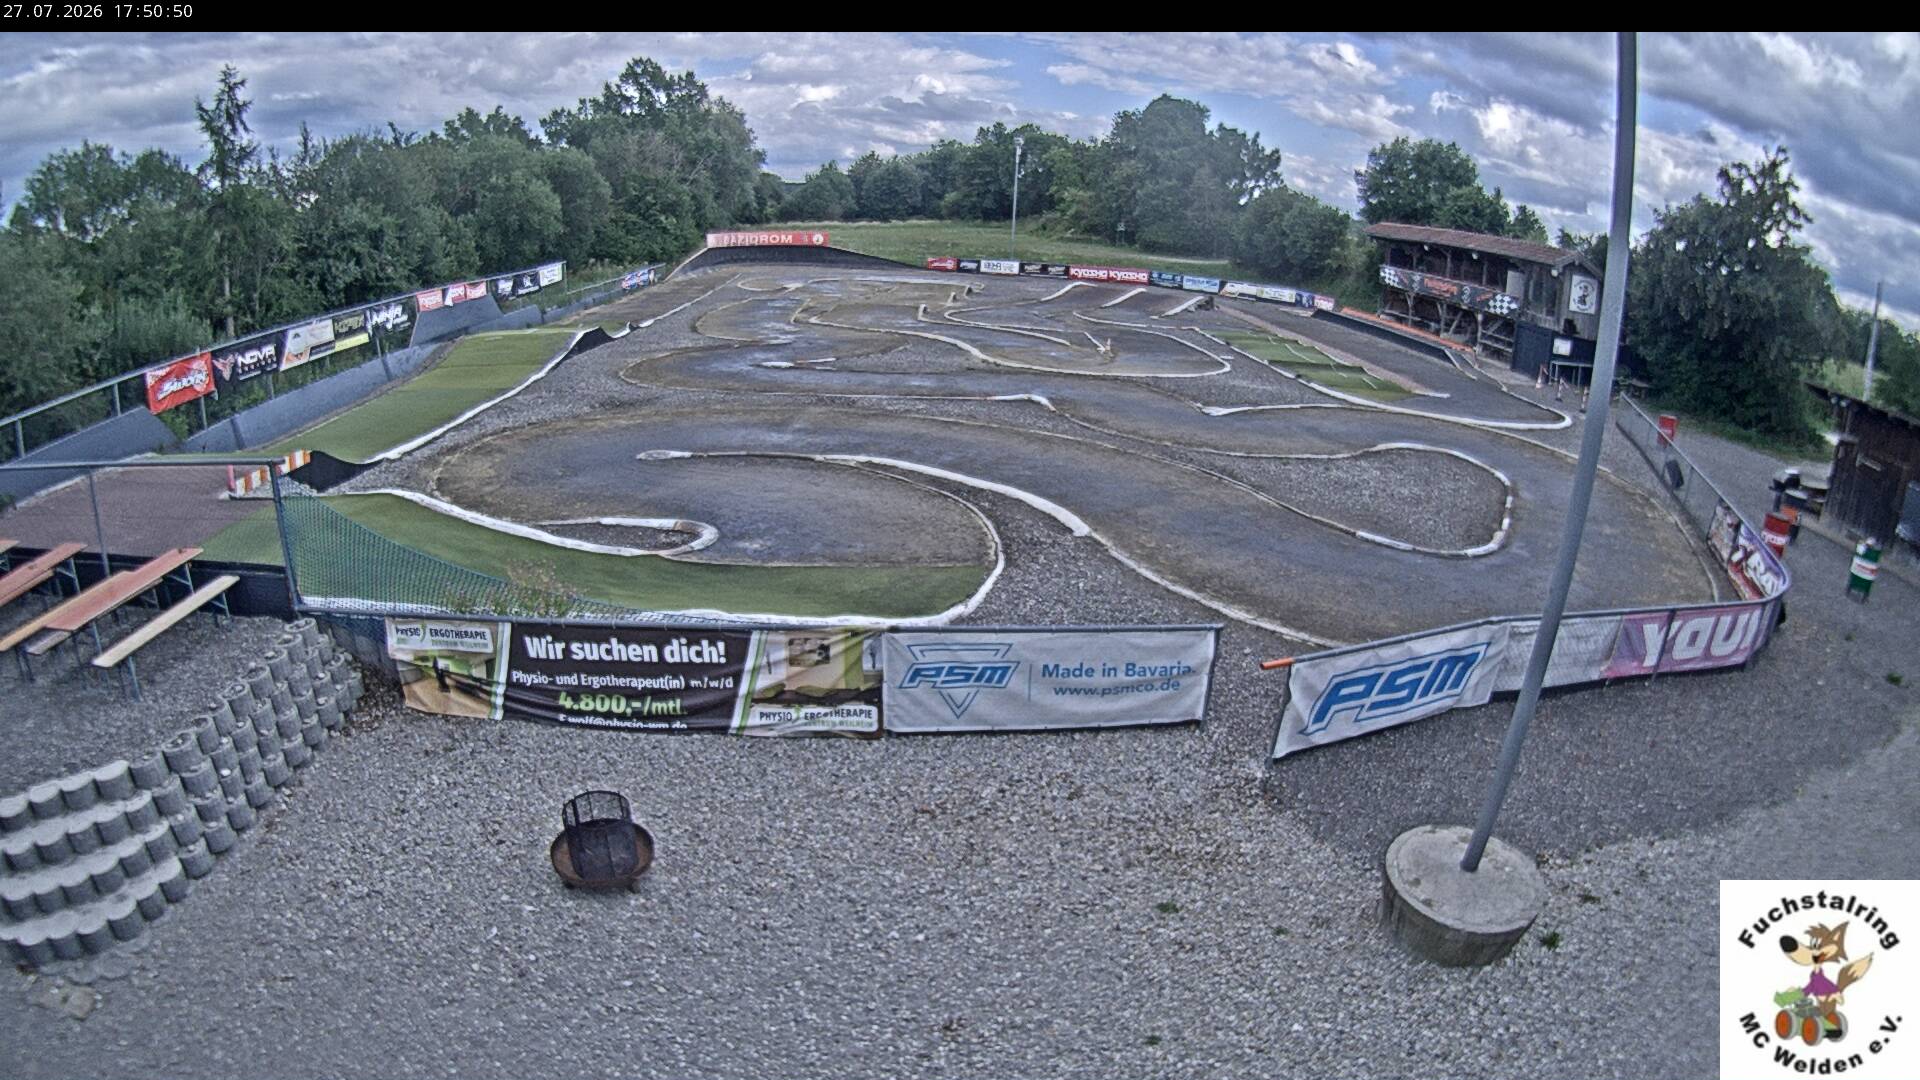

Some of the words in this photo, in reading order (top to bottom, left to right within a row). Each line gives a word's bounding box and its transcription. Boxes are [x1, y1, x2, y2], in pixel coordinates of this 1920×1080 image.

[236, 344, 276, 366] NOVA
[429, 627, 488, 641] ERGOTHERAPIE
[524, 636, 567, 660] Wir
[570, 637, 659, 663] suchen
[663, 638, 727, 664] dich!
[903, 663, 1014, 687] PSM
[1041, 662, 1095, 679] Made
[1101, 662, 1119, 678] in
[511, 671, 554, 686] Physio-
[556, 672, 579, 686] und
[580, 674, 686, 690] Ergotherapeut(in)
[690, 677, 734, 690] m/w/d
[1053, 678, 1181, 697] www.psmco.de
[1310, 651, 1483, 725] PSM
[759, 711, 793, 721] PHYSIO
